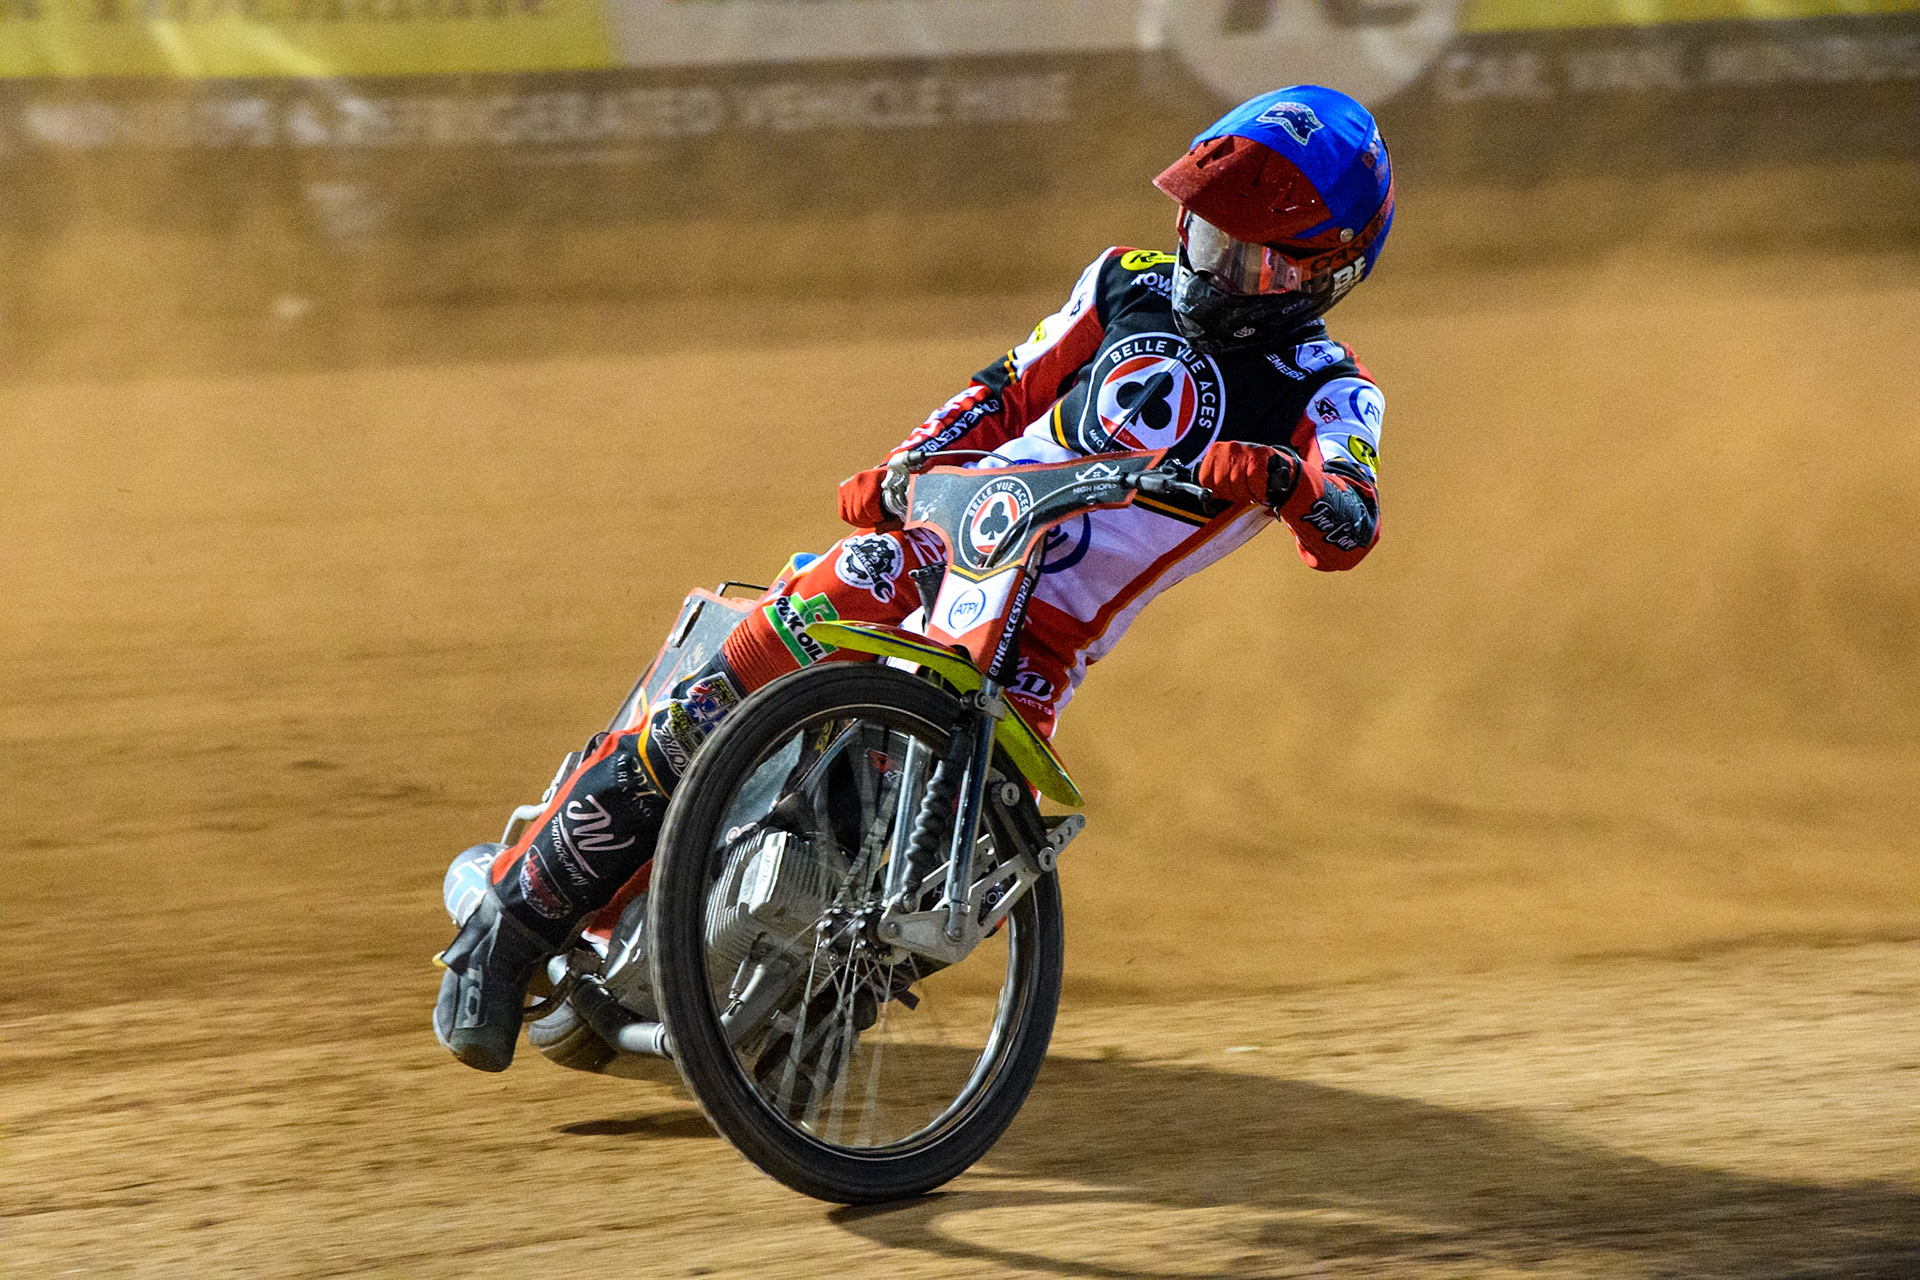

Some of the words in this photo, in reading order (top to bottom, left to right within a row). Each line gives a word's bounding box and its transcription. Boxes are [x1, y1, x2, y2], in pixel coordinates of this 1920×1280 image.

[1110, 340, 1167, 363] BELLE
[1175, 345, 1206, 373] VUE
[1199, 381, 1216, 429] ACES
[967, 486, 993, 516] BELLE
[996, 482, 1015, 491] VUE
[1014, 488, 1029, 512] ACES
[954, 601, 981, 616] ATPI
[797, 633, 823, 661] OIL
[567, 794, 636, 851] JW
